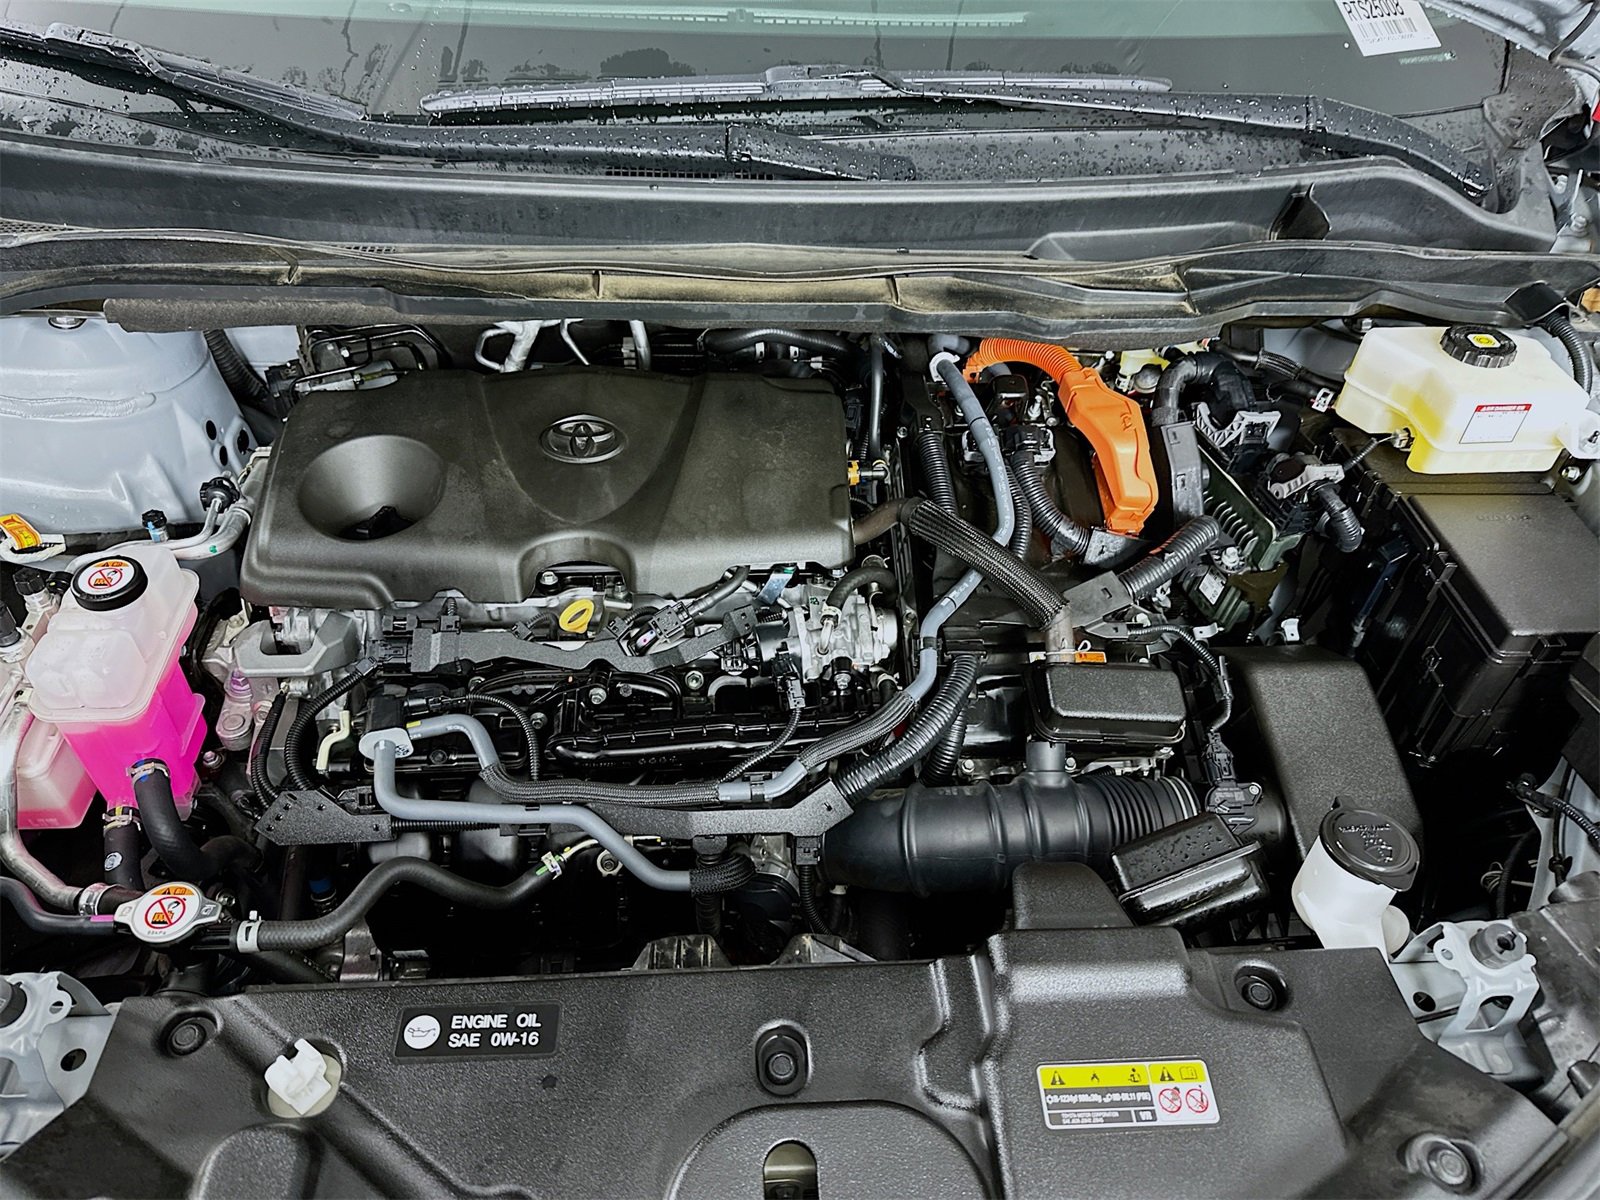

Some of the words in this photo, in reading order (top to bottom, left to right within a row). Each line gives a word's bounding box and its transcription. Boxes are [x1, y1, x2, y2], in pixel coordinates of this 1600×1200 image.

[1342, 0, 1405, 21] RTS25008
[451, 1014, 508, 1029] ENGINE
[516, 1013, 542, 1028] OIL
[448, 1033, 481, 1048] SAE
[490, 1032, 540, 1047] 0W-16
